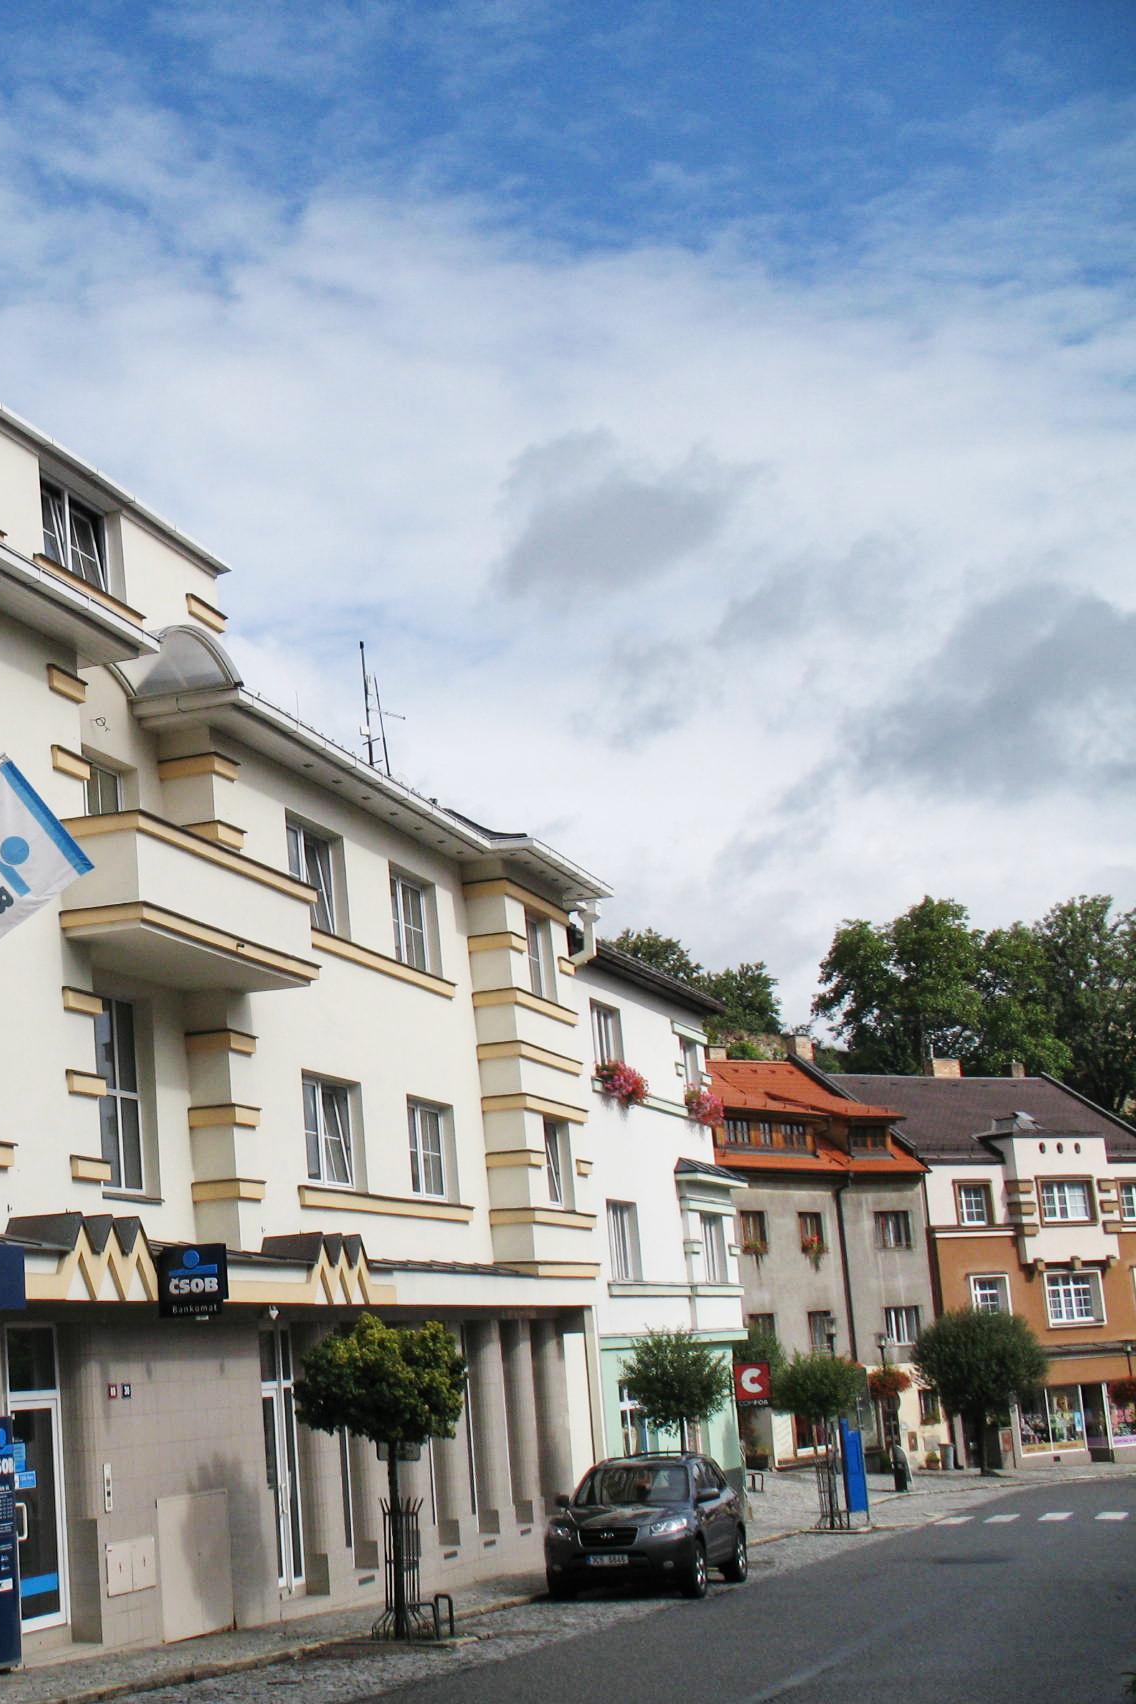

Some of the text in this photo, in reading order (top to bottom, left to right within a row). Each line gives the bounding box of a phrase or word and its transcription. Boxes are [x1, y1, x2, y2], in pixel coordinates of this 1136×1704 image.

[168, 1277, 218, 1295] ČSOB
[172, 1303, 218, 1314] Bankomat
[741, 1367, 763, 1393] C
